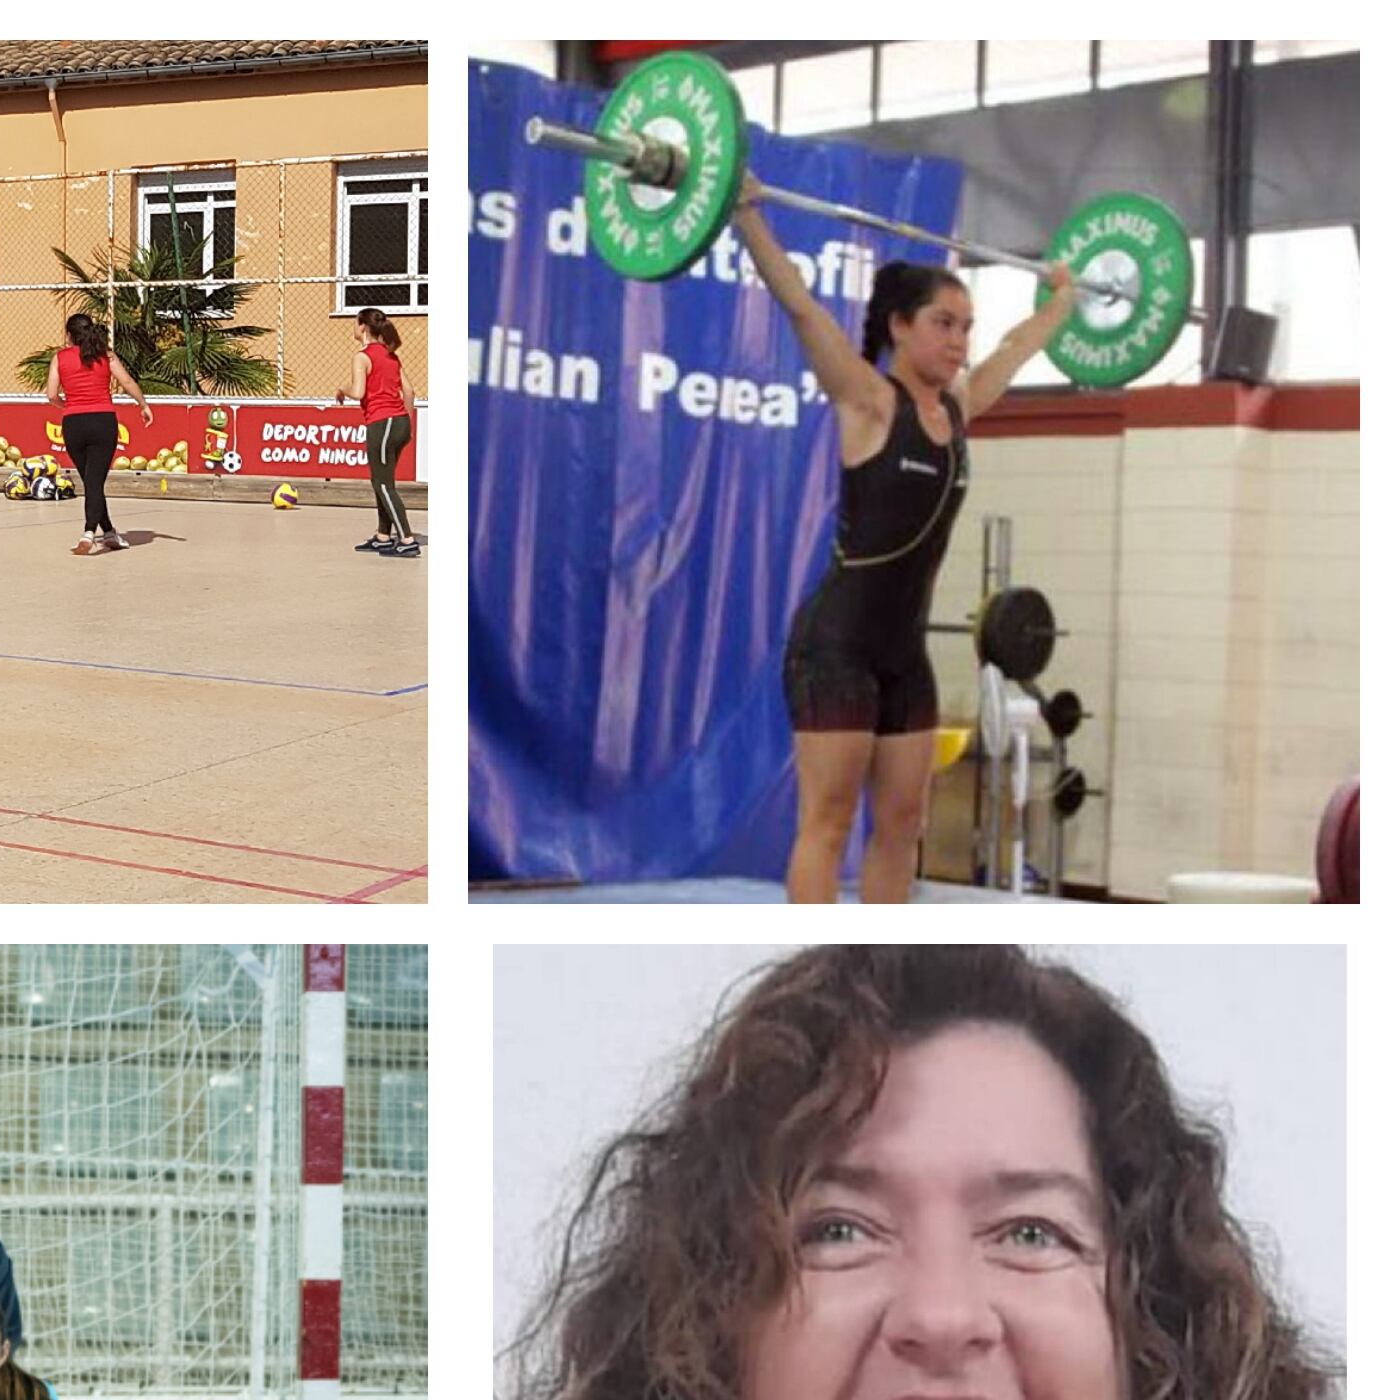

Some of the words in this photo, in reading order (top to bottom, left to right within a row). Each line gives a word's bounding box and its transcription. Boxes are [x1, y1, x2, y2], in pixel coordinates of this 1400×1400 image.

[262, 422, 367, 445] DEPORTIVID
[261, 447, 310, 463] COMO
[318, 448, 368, 466] NINGU
